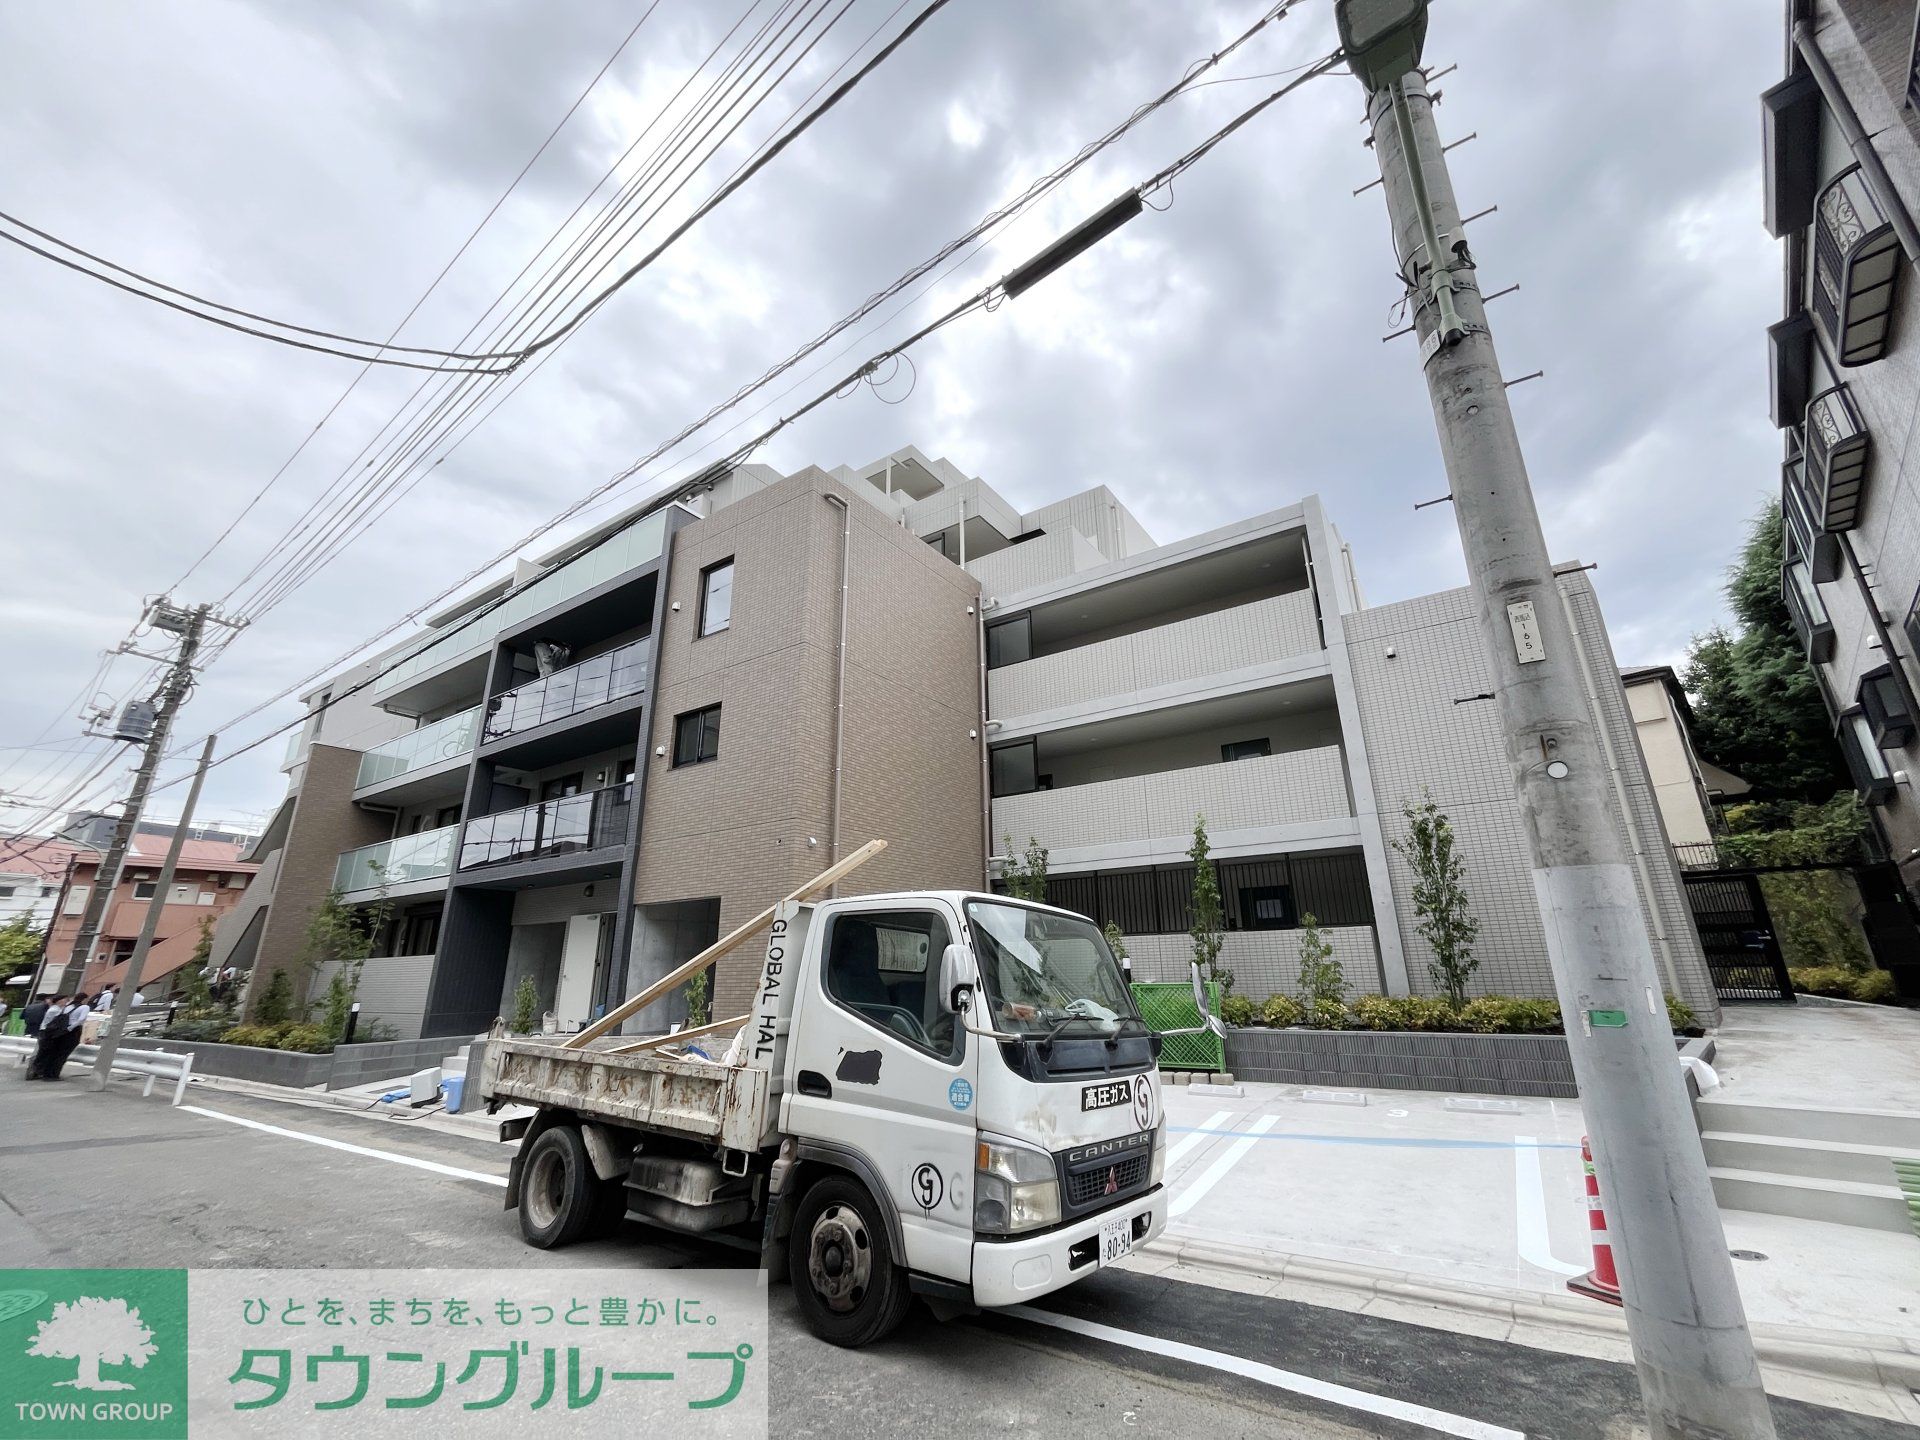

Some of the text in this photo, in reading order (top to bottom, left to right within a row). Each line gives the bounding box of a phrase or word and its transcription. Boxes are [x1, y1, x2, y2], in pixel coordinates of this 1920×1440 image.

[755, 919, 788, 1060] GLOBAL HAL
[1085, 1084, 1129, 1110] 高圧ガス
[1069, 1134, 1149, 1162] CANTER
[1107, 1231, 1131, 1260] 80-94
